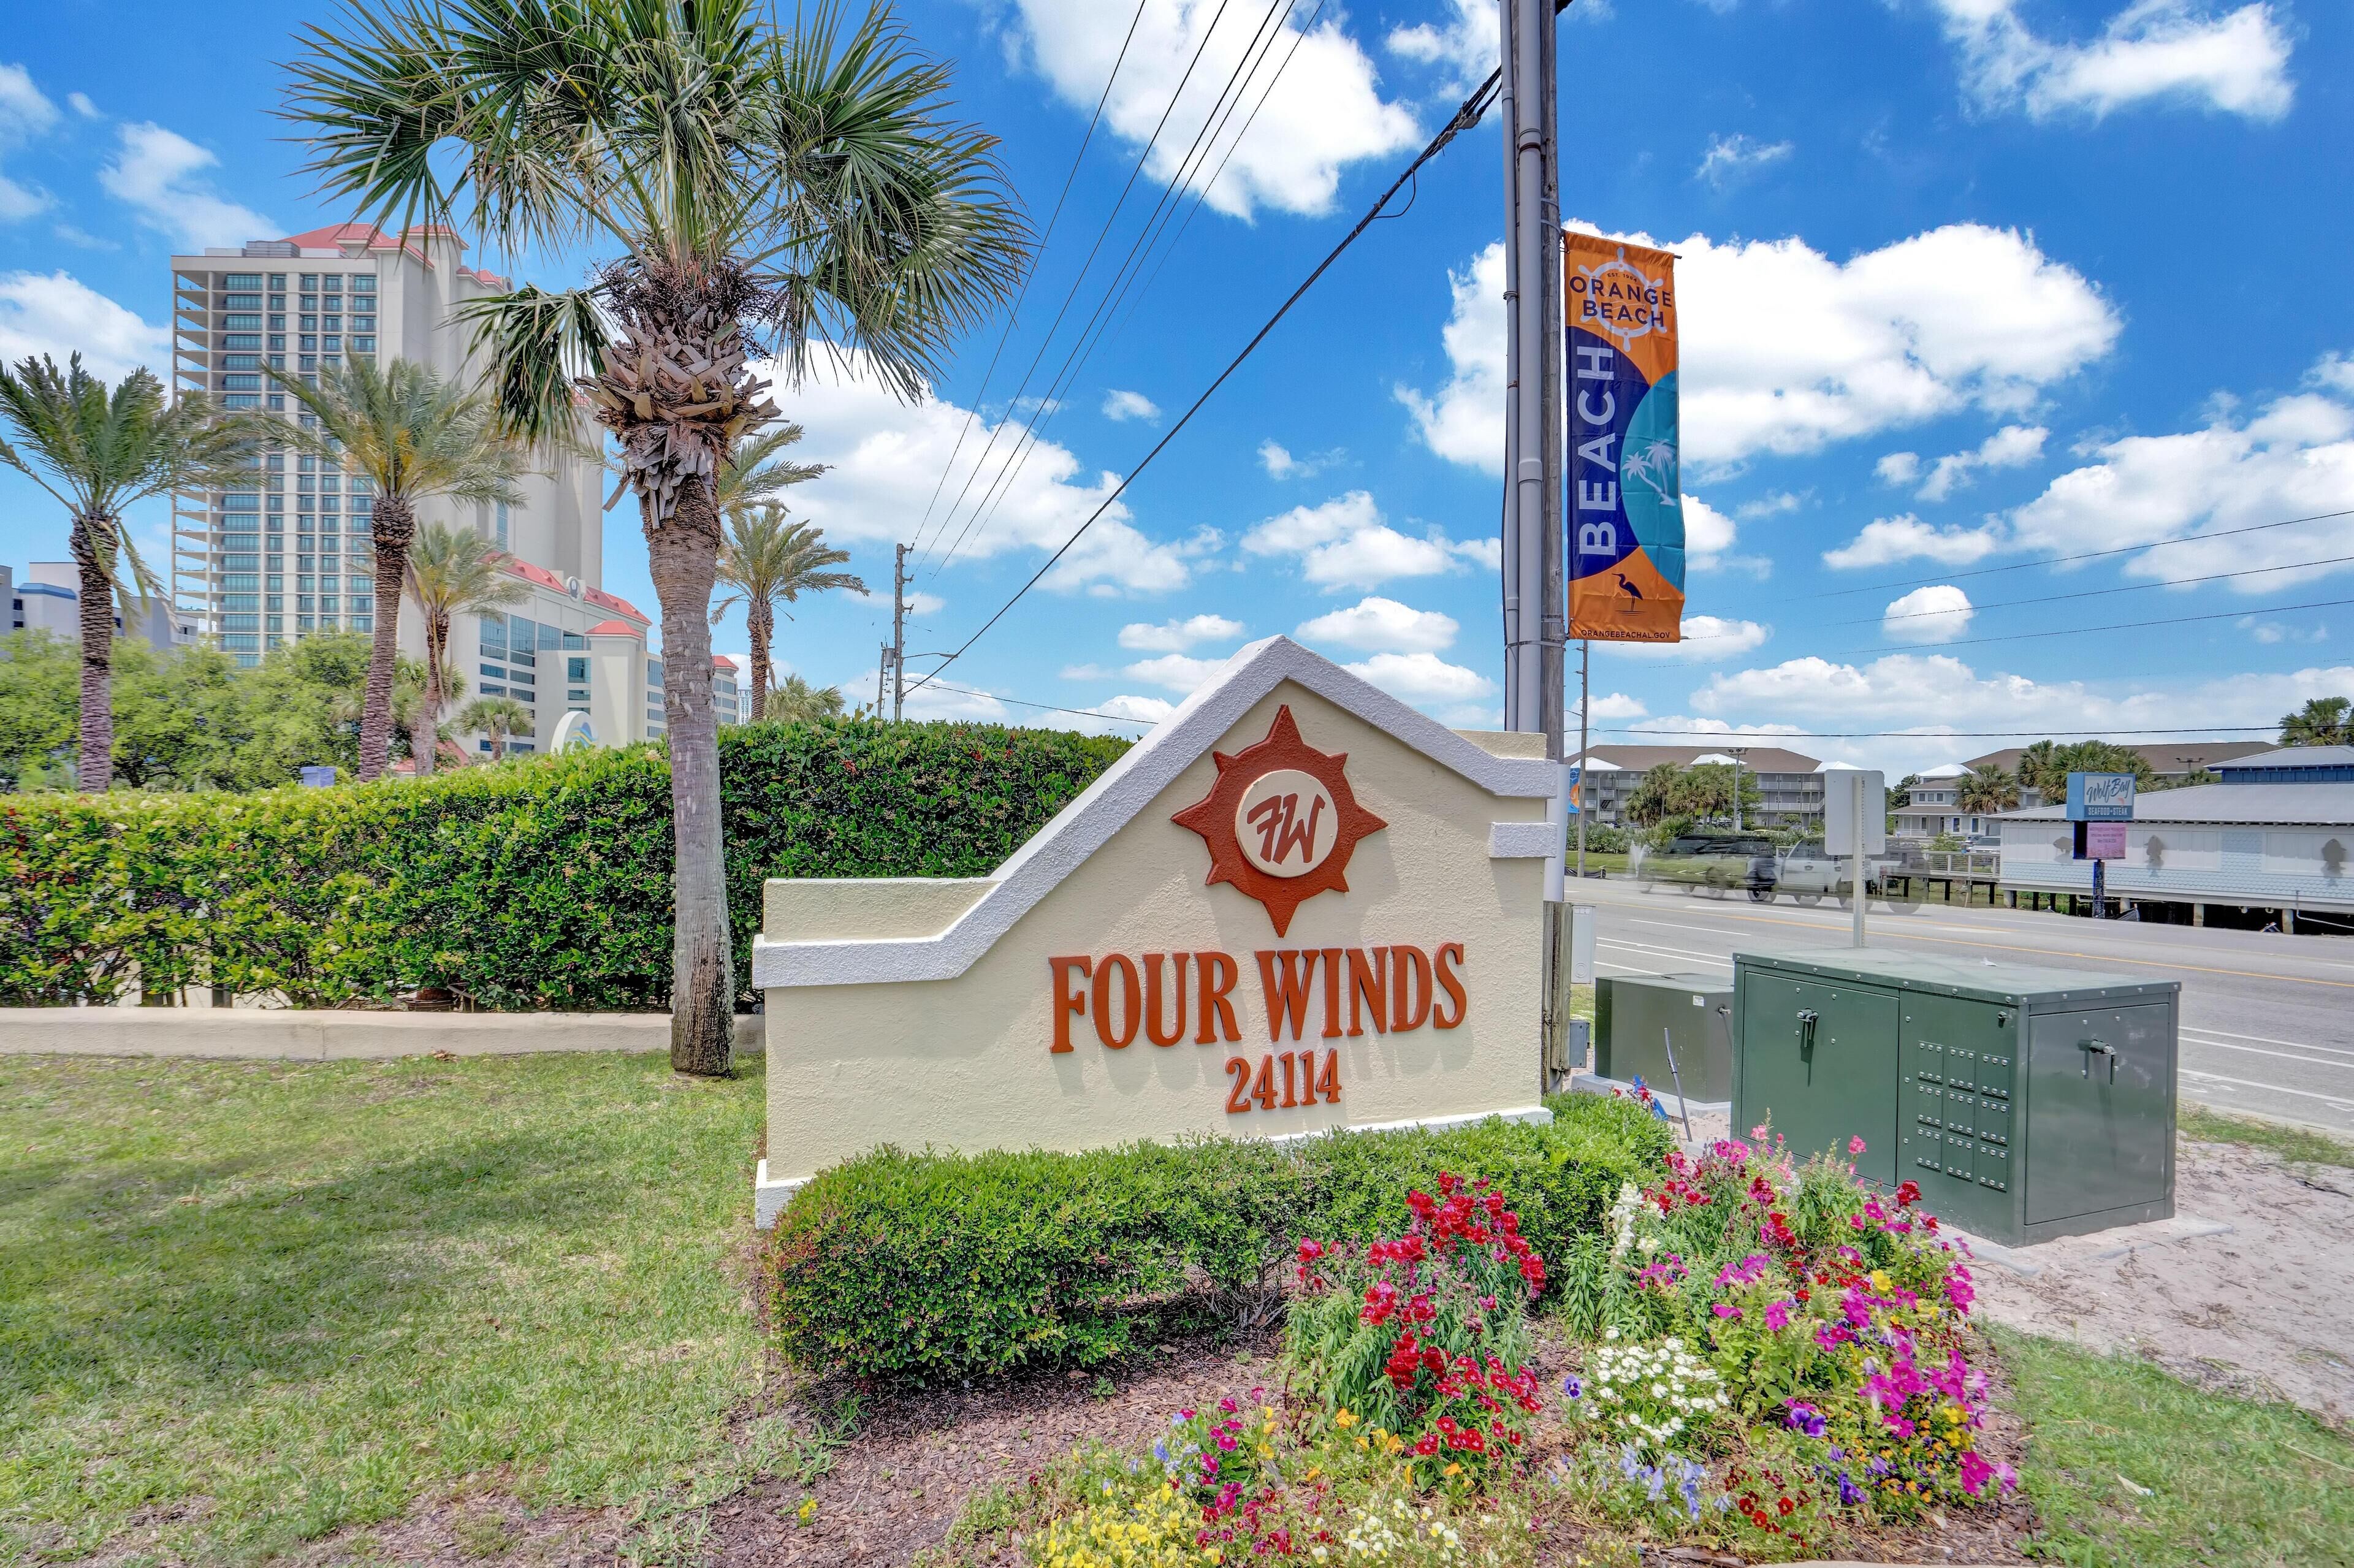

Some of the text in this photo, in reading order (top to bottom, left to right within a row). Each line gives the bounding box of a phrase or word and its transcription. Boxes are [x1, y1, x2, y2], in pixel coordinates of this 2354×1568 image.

[1570, 276, 1672, 307] ORANGE
[1583, 300, 1664, 327] BEACH
[1577, 346, 1617, 555] BEACH
[1580, 630, 1670, 639] ORANGEBEACHAL.GOV
[2086, 778, 2130, 803] Wolf Bay
[1247, 793, 1325, 865] FW
[1048, 942, 1467, 1054] FOUR WINDS
[1225, 1048, 1343, 1113] 24114
